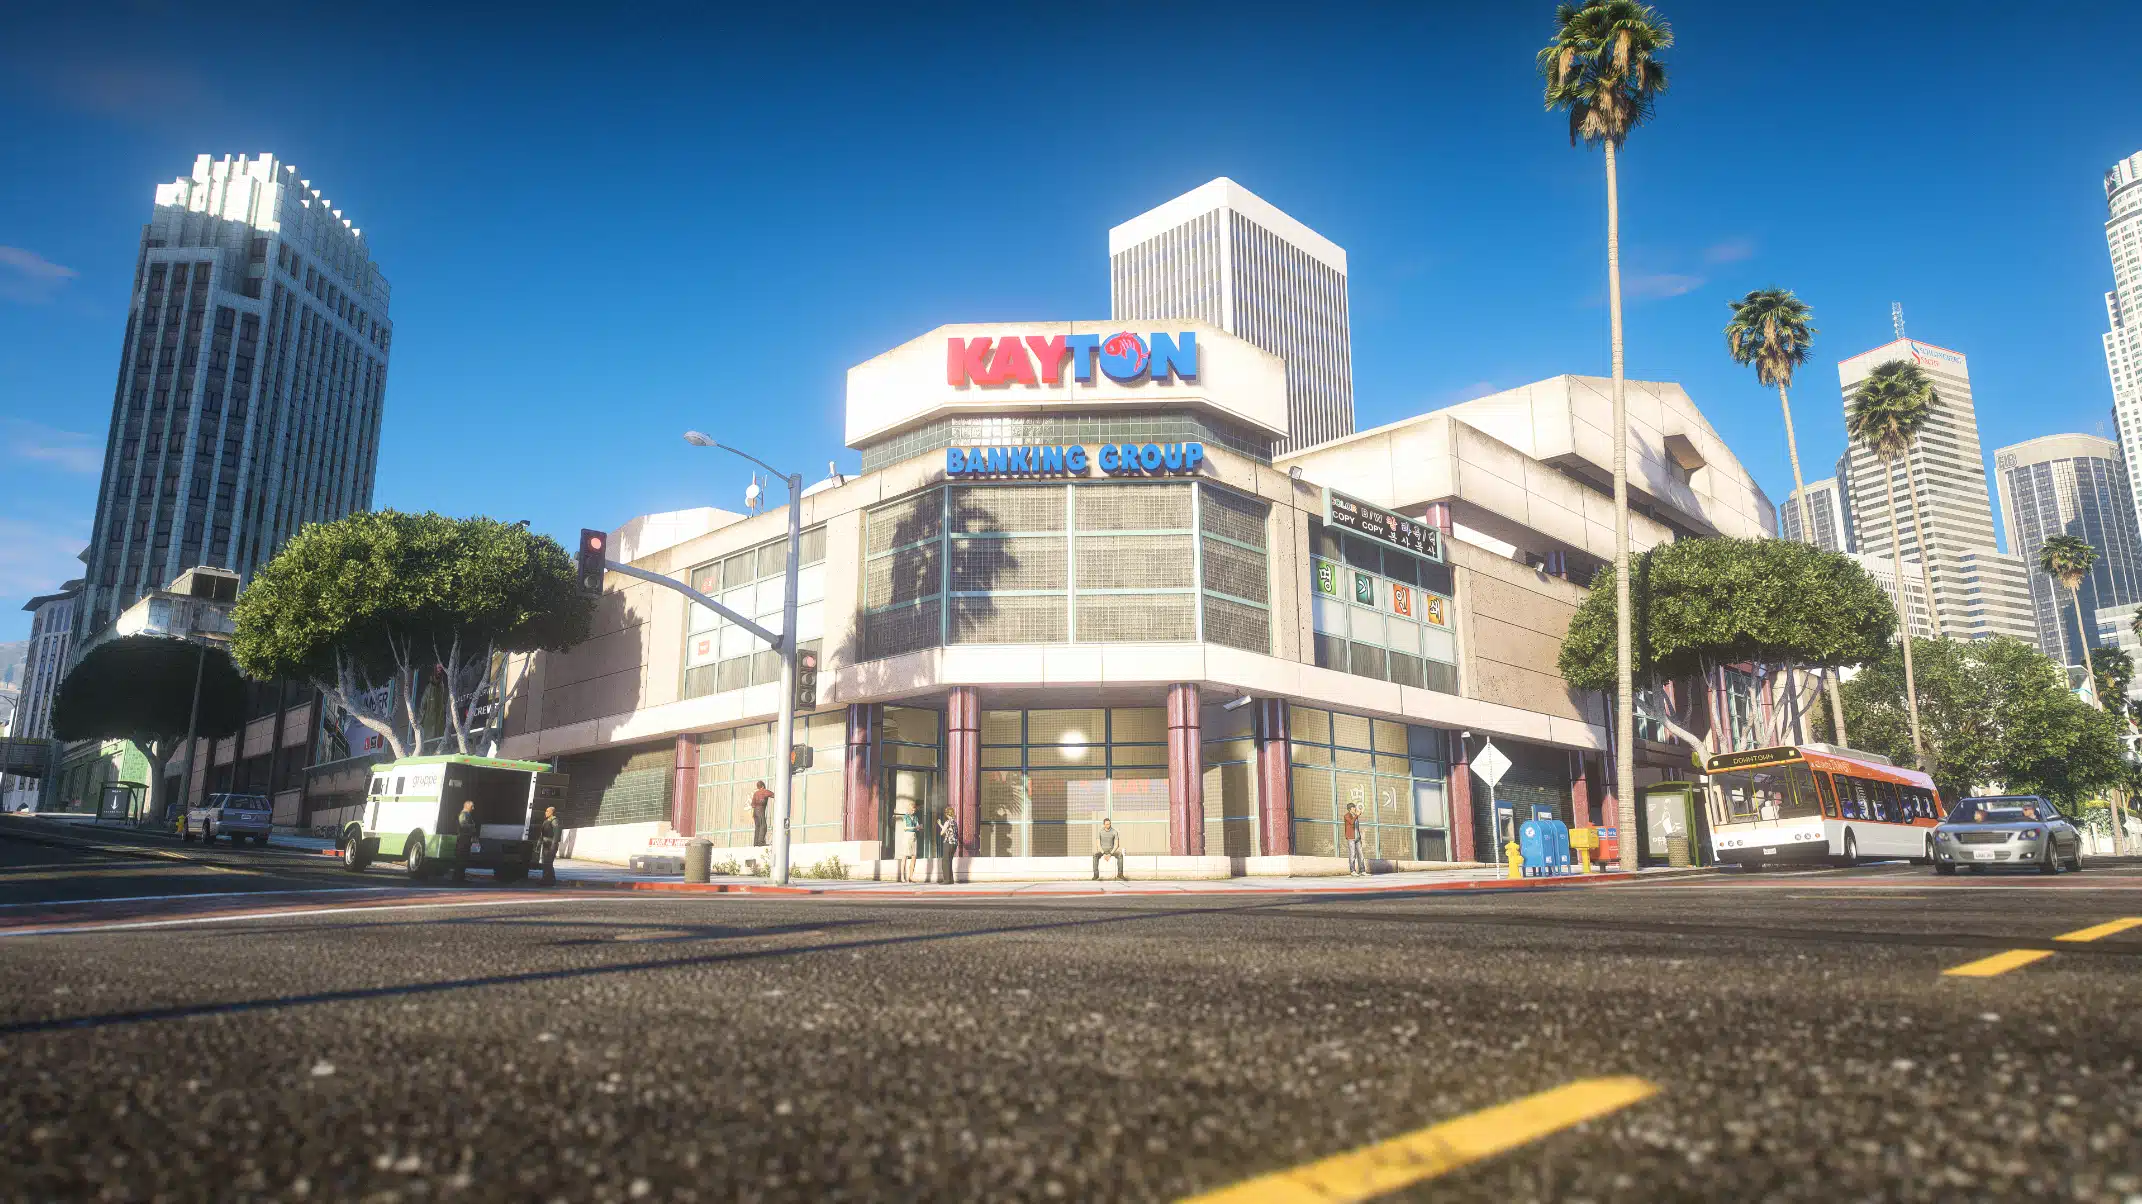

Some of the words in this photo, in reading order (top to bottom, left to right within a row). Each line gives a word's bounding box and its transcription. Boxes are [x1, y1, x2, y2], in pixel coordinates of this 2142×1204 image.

[947, 331, 1196, 385] KAYTON
[947, 444, 1087, 476] BANKING
[1098, 442, 1204, 475] GROUP
[1332, 510, 1356, 525] COPY
[1361, 521, 1384, 535] COPY
[1732, 753, 1774, 765] DOWNTOWN
[412, 775, 437, 788] gruppe
